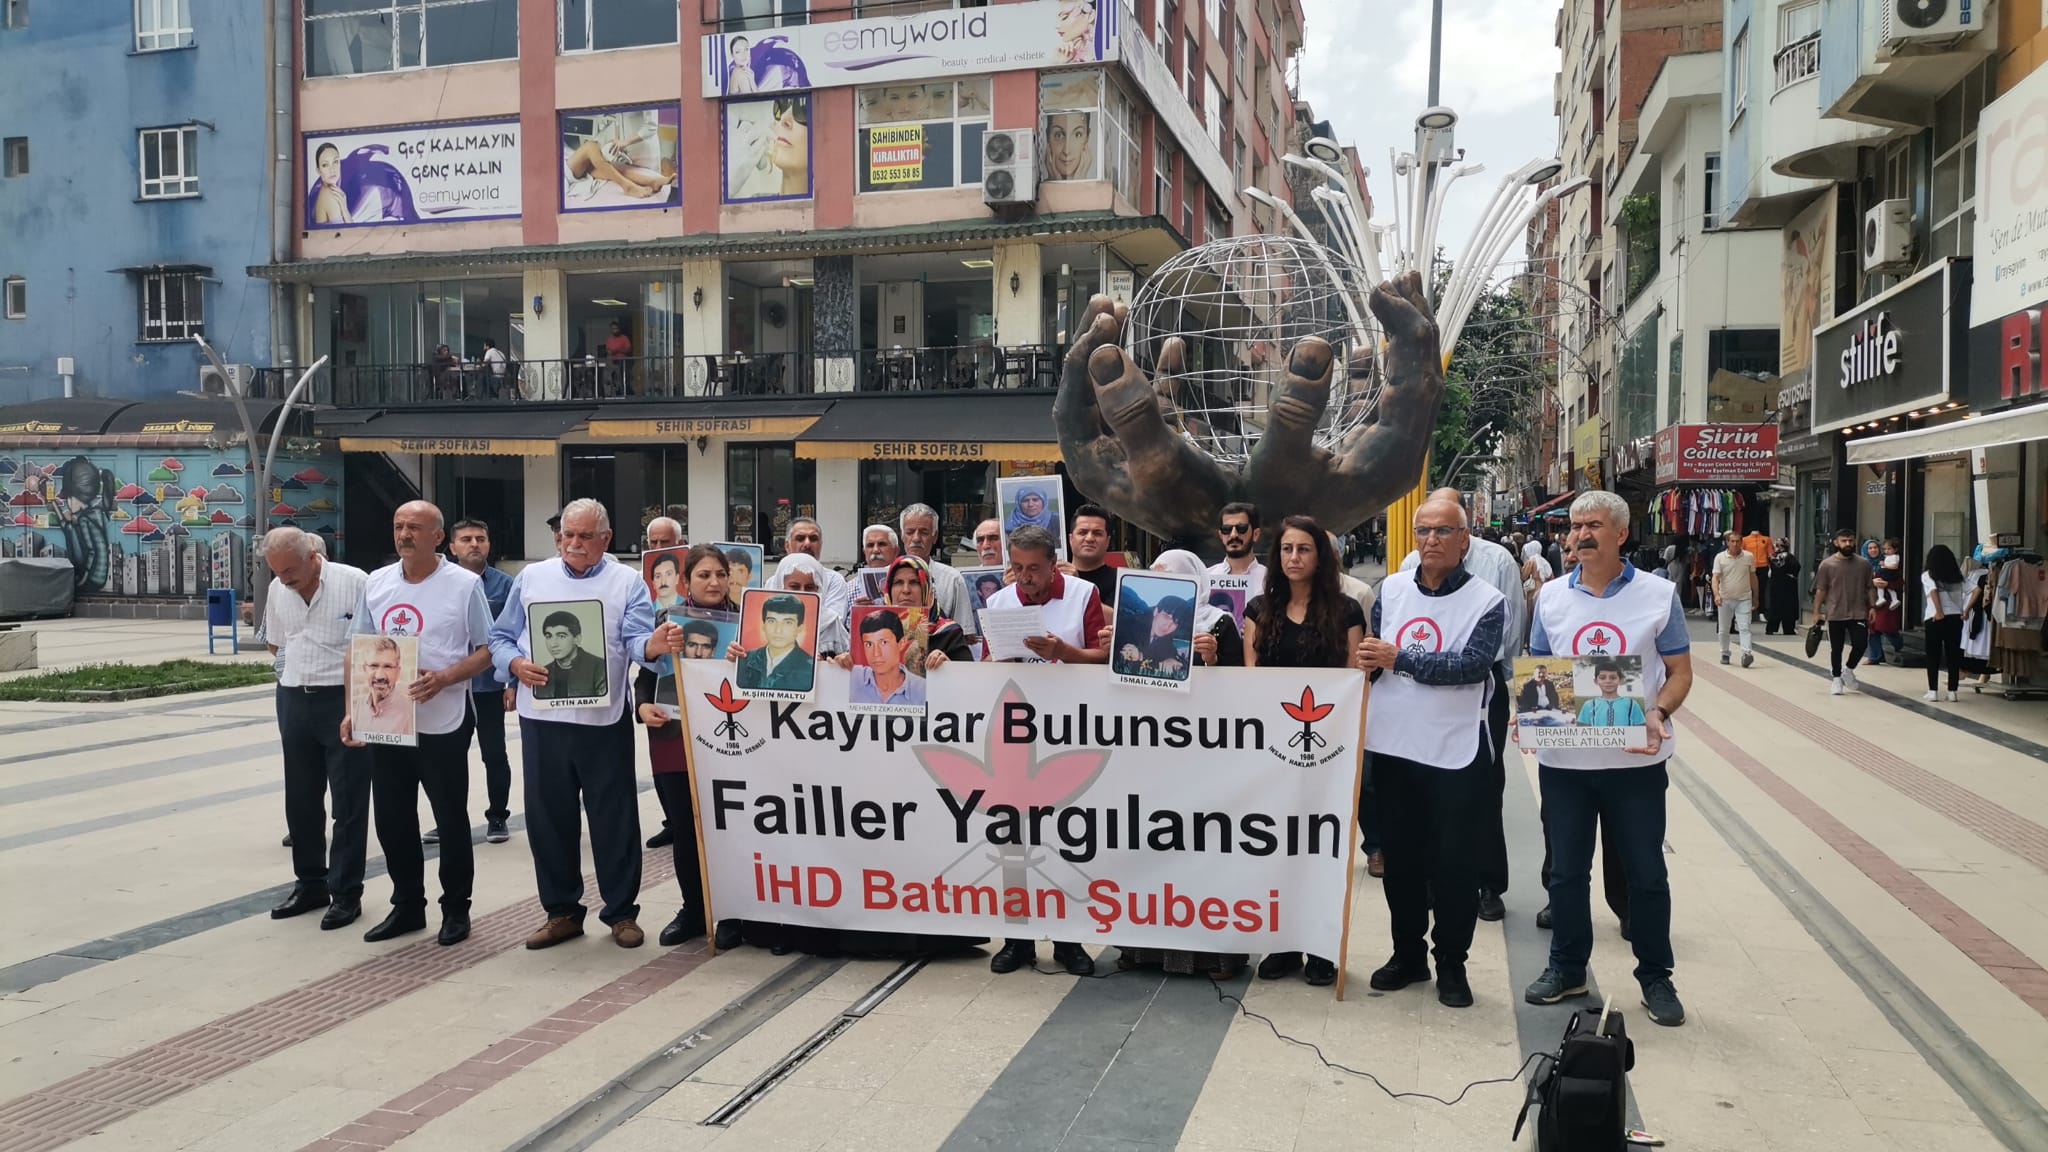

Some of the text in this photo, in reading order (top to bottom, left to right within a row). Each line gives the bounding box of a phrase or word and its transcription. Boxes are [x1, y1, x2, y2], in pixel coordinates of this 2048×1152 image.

[941, 58, 969, 69] beauty
[976, 54, 1007, 65] medical
[1014, 51, 1046, 61] esthetic
[430, 133, 516, 153] KALMAYIN
[454, 161, 502, 177] KALIN
[872, 170, 887, 180] 0532
[889, 169, 901, 179] 553
[1840, 311, 1899, 389] stilife
[656, 419, 751, 434] ŞEHİR SOFRASI
[438, 439, 490, 451] SOFRASI
[1696, 428, 1759, 449] Şirin
[873, 443, 984, 457] ŞEHİR SOFRASI
[1683, 446, 1774, 459] Collection
[1219, 578, 1249, 588] ÇELİK
[1120, 675, 1149, 685] İSMAİL
[742, 690, 807, 701] M.ŞİRİN MALTU
[550, 698, 599, 707] ÇETİN ABAY
[849, 704, 878, 712] MEHMET
[1003, 703, 1266, 750] Bulunsun
[1535, 727, 1626, 736] İBRAHİM ATILGAN
[1536, 738, 1626, 747] VEYSEL ATILGAN
[715, 746, 743, 756] HAKLARI
[711, 778, 1341, 864] Failler Yargılansın
[753, 852, 1280, 933] İHD Batman Şubesi
